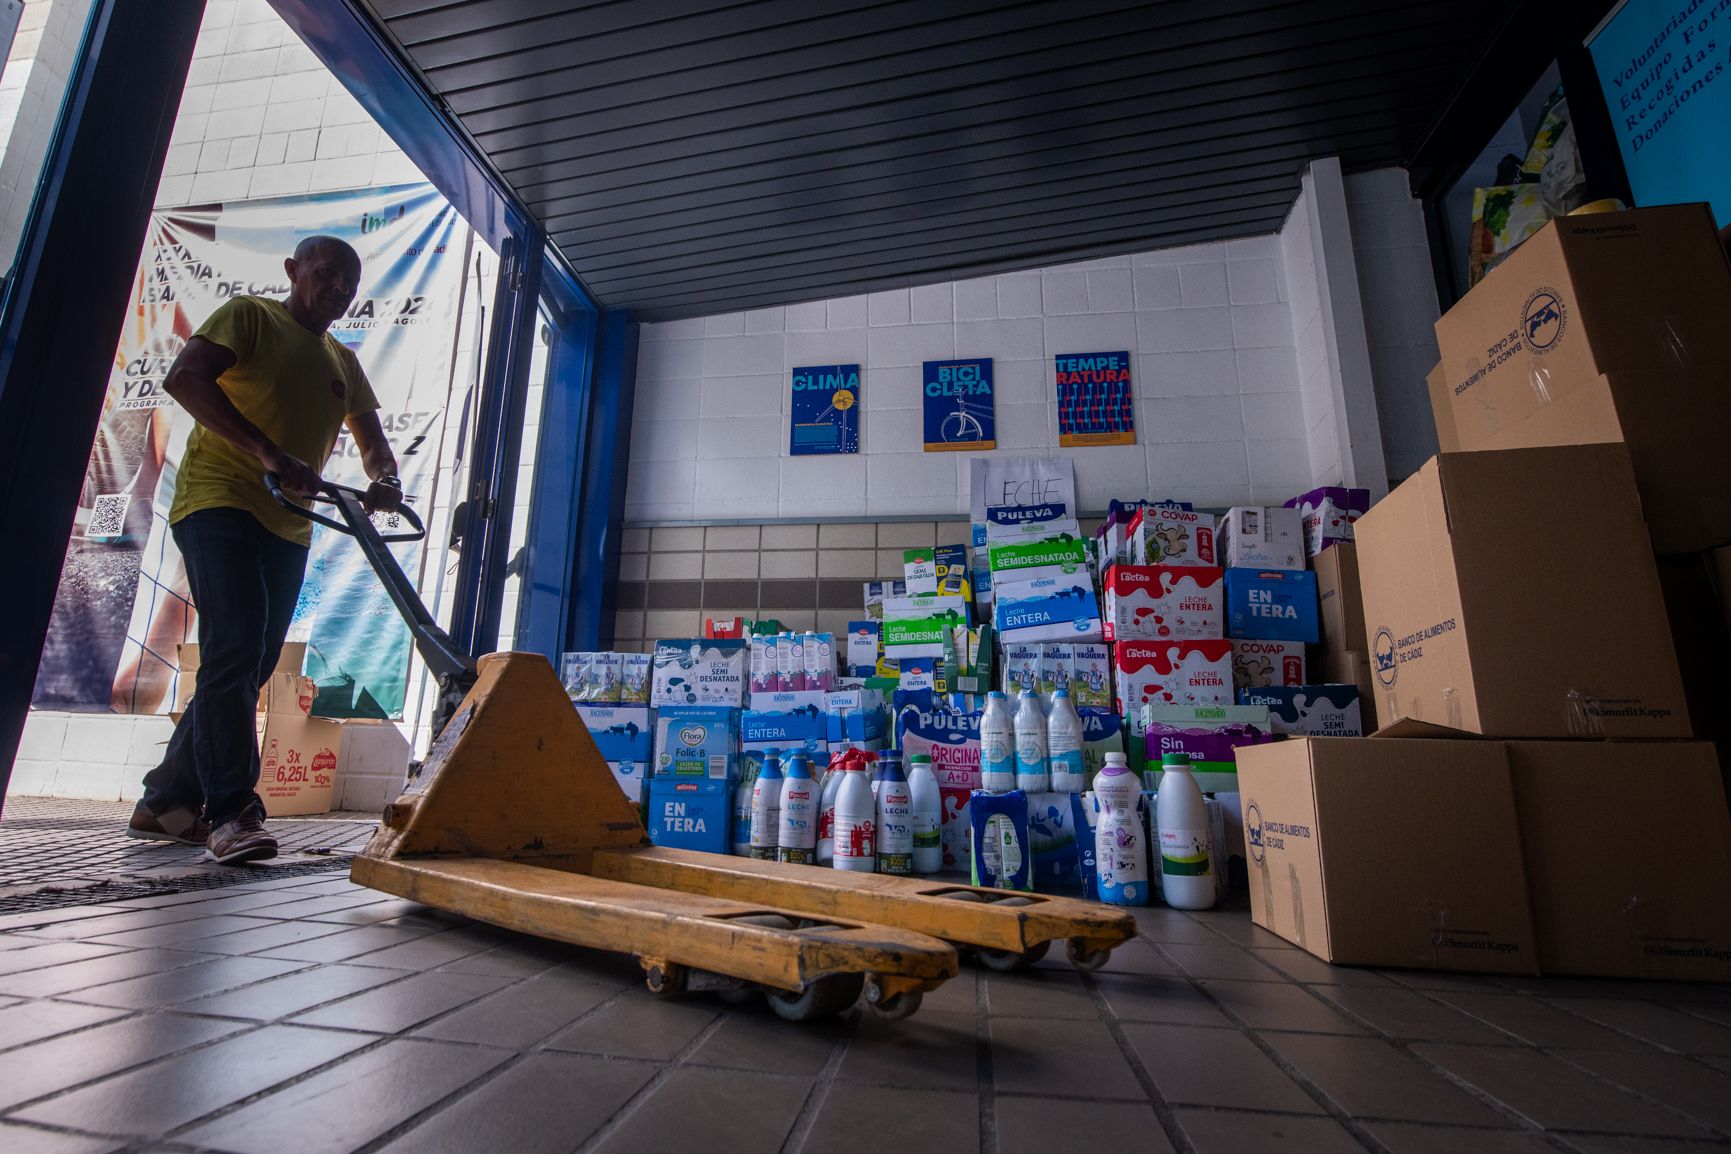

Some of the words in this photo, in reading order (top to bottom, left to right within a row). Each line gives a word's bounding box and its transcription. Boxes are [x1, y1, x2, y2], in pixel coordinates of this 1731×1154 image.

[1613, 0, 1705, 89] Voluntariad
[1619, 53, 1673, 112] Equipo
[1625, 39, 1717, 133] Recogidas
[1632, 62, 1724, 155] Donaciones
[1507, 330, 1520, 342] DE
[1498, 342, 1523, 367] BANCO
[1486, 361, 1499, 373] DE
[939, 366, 981, 383] BICI
[1056, 369, 1132, 385] RATURA
[792, 373, 859, 392] CLIMA
[1455, 367, 1488, 397] ALIMENTOS
[926, 380, 992, 398] CLETA
[984, 473, 1065, 508] LECHE
[997, 508, 1054, 520] PULEVA
[1161, 510, 1198, 522] COVAP
[997, 551, 1016, 559] Leche
[997, 552, 1080, 567] SEMIDESNATADA
[1248, 589, 1272, 604] EN
[1005, 608, 1025, 616] Leche
[1179, 602, 1213, 611] ENTERA
[1248, 603, 1298, 620] TERA
[1006, 611, 1051, 627] ENTERA
[888, 630, 944, 642] SEMIDESNAT
[1397, 634, 1416, 649] BANCO
[1416, 631, 1424, 643] DE
[1424, 618, 1457, 639] ALIMENTOS
[1240, 643, 1285, 655] COVAP
[1009, 652, 1038, 660] VAQUERA
[1076, 652, 1106, 660] VAQUERA
[1400, 652, 1408, 663] DE
[700, 675, 740, 683] DESNATADA
[1189, 678, 1224, 687] ENTERA
[1320, 713, 1346, 721] LECHE
[1639, 707, 1671, 719] Kappa
[919, 712, 981, 731] PULEV
[1323, 721, 1344, 730] SEMI
[683, 731, 702, 741] Flora
[748, 728, 787, 739] ENTERA
[1160, 737, 1185, 749] Sin
[286, 749, 301, 764] 3x
[675, 748, 696, 758] Folic
[931, 743, 982, 765] ORIGINA
[276, 766, 310, 785] 6,25L
[947, 772, 969, 783] A+D
[664, 801, 686, 817] EN
[885, 807, 909, 815] LECHE
[664, 817, 707, 833] TERA
[1264, 821, 1279, 833] BANCO
[1285, 823, 1311, 839] ALIMENTOS
[1487, 940, 1520, 953] Kappa
